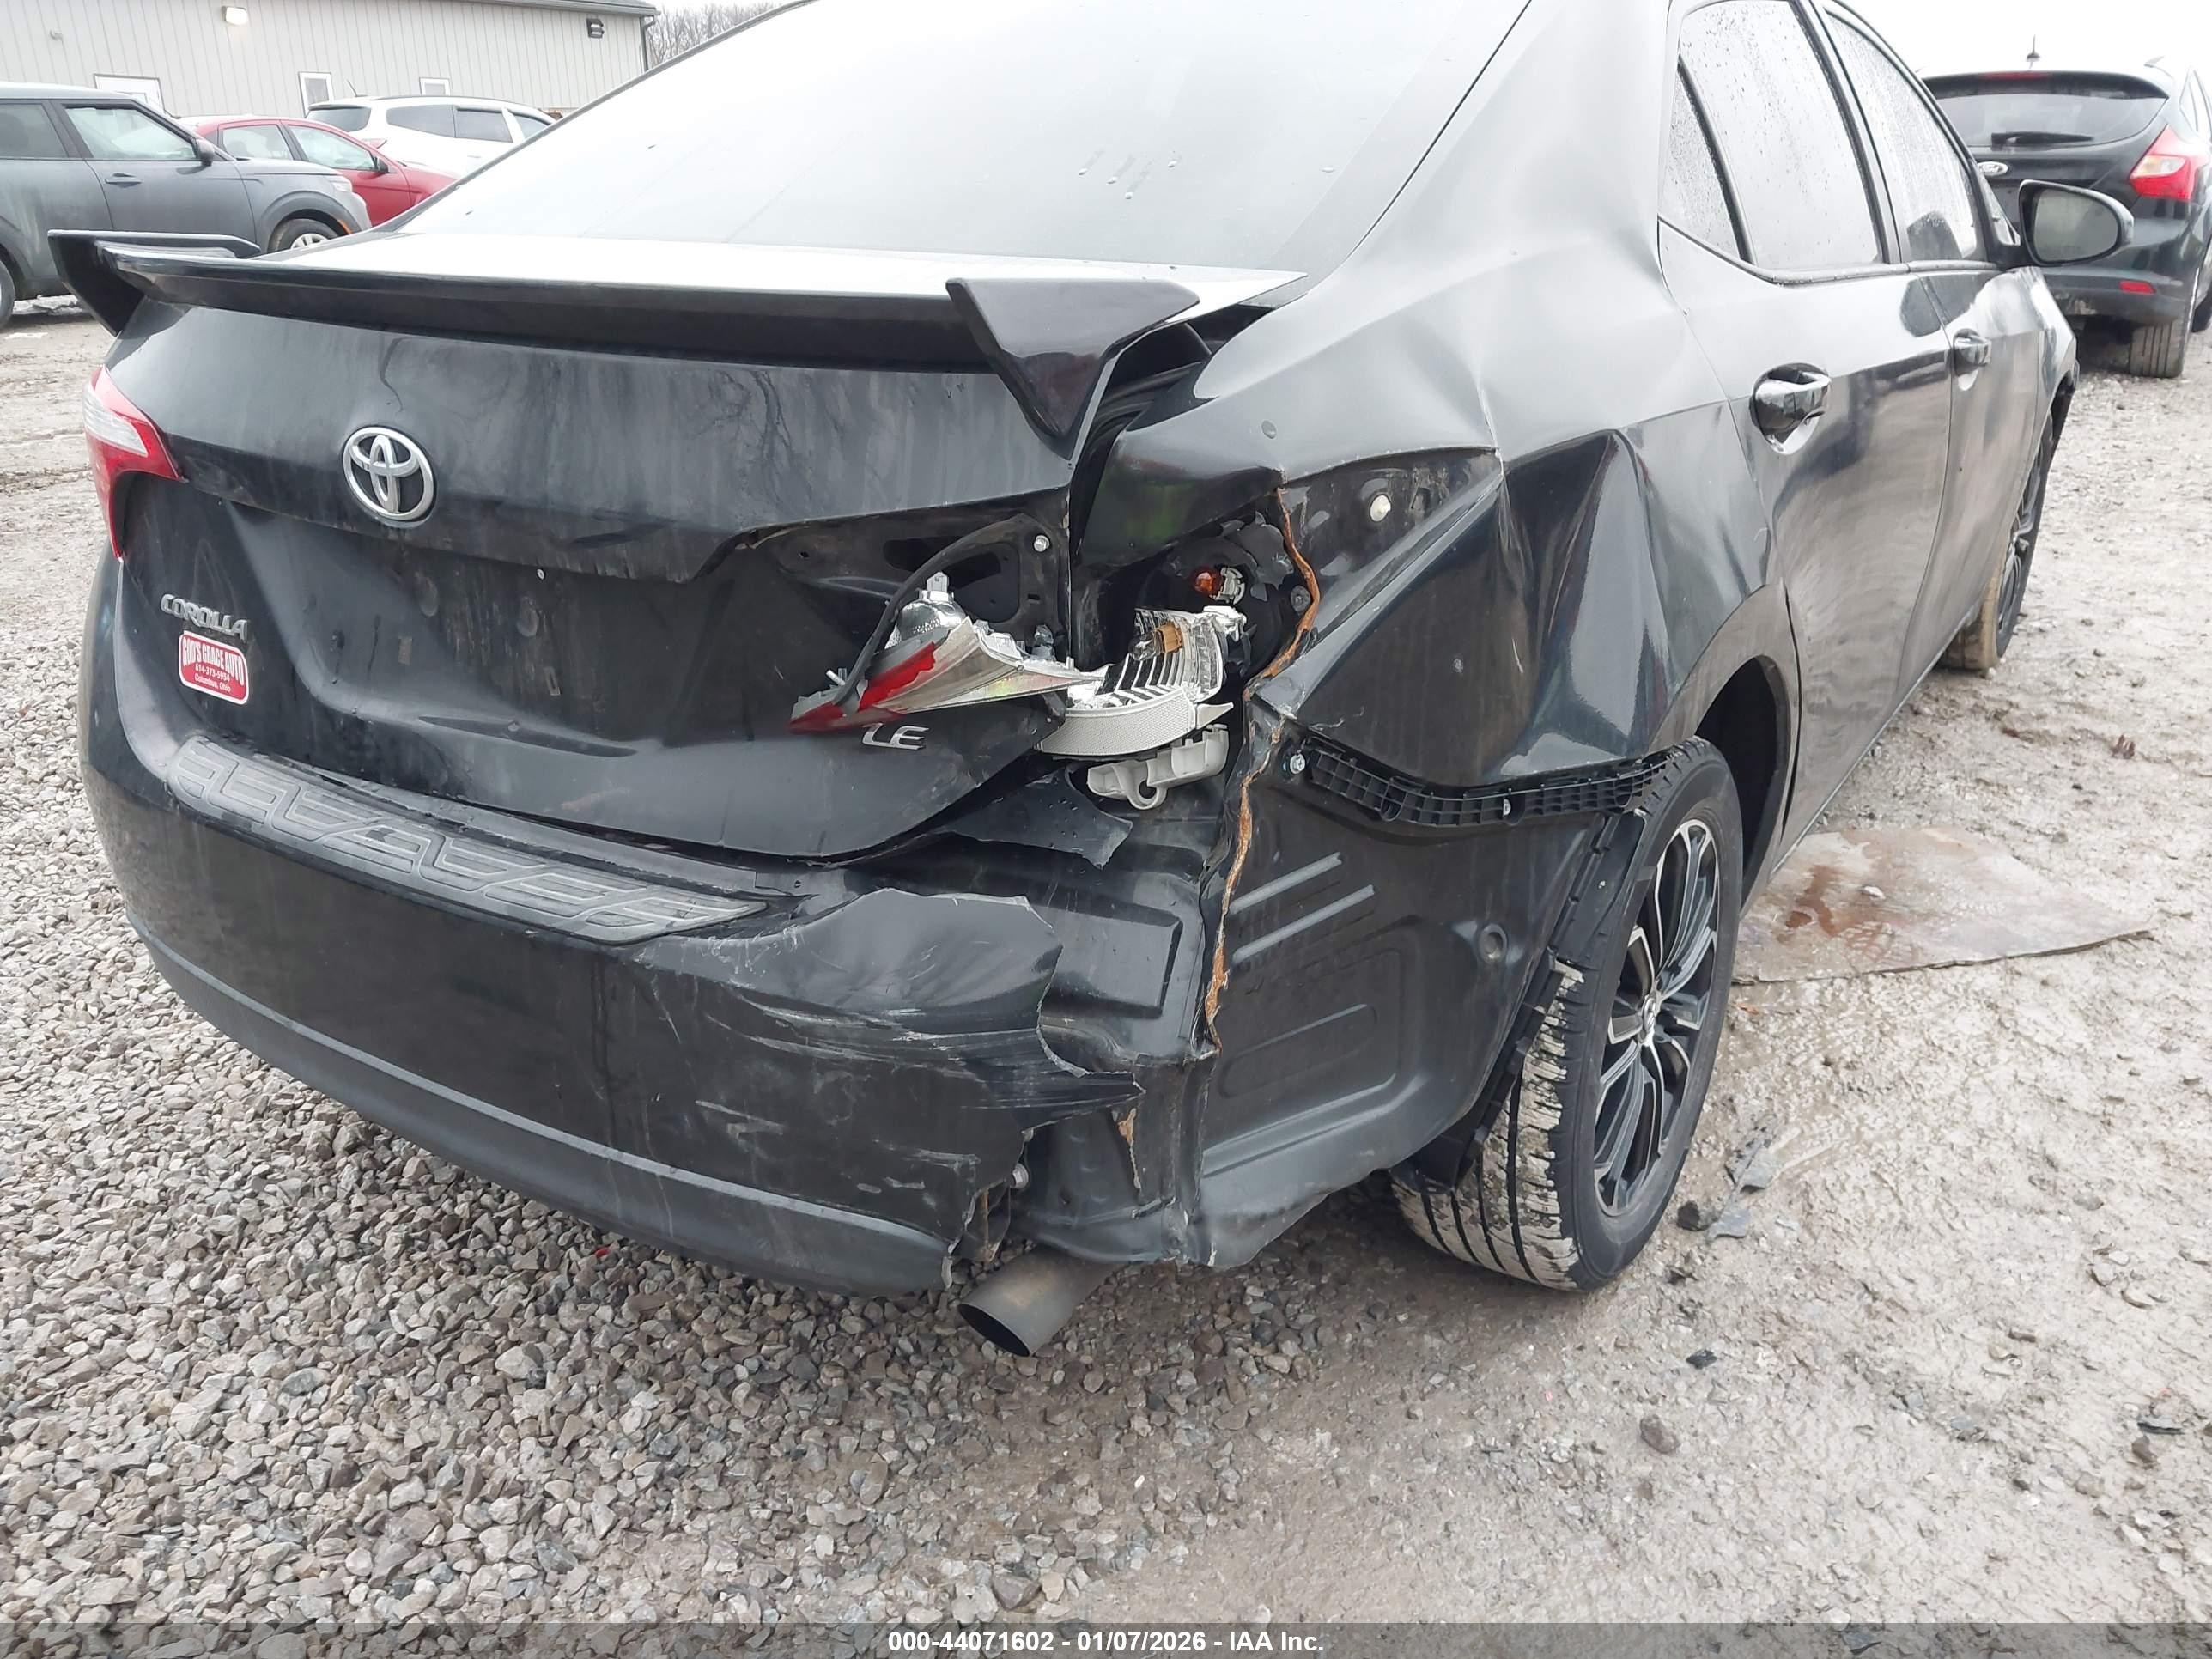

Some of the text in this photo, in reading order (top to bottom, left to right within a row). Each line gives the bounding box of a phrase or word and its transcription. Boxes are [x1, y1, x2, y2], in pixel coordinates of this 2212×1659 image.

[161, 593, 247, 643] COROLLA
[202, 644, 225, 670] GRACE
[224, 652, 245, 686] AUTO
[862, 722, 929, 750] LE
